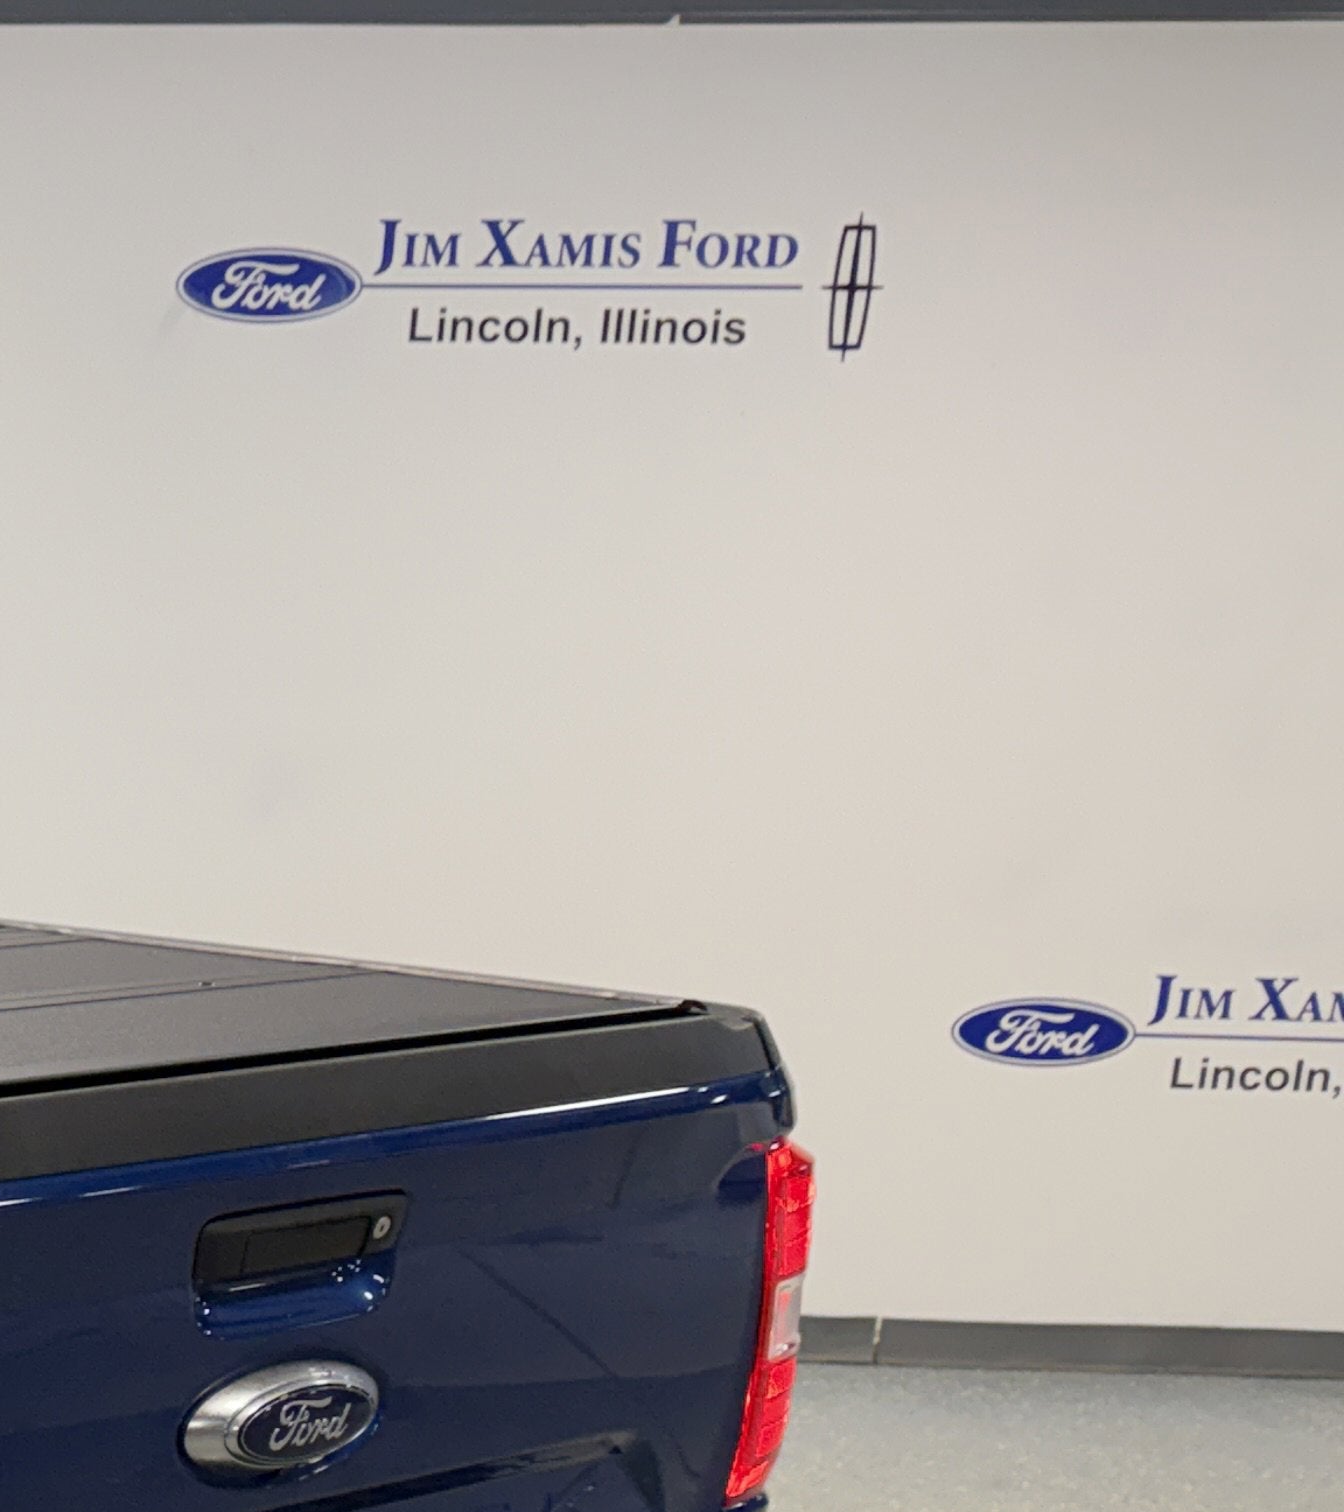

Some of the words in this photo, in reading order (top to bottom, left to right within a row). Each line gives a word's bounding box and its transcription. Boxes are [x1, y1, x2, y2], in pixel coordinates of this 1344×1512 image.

[213, 260, 323, 312] Ford
[408, 307, 582, 351] Lincoln,
[600, 308, 746, 346] Illinois
[984, 1008, 1100, 1056] Ford
[1169, 1057, 1342, 1099] Lincoln,
[269, 1396, 351, 1451] Ford
